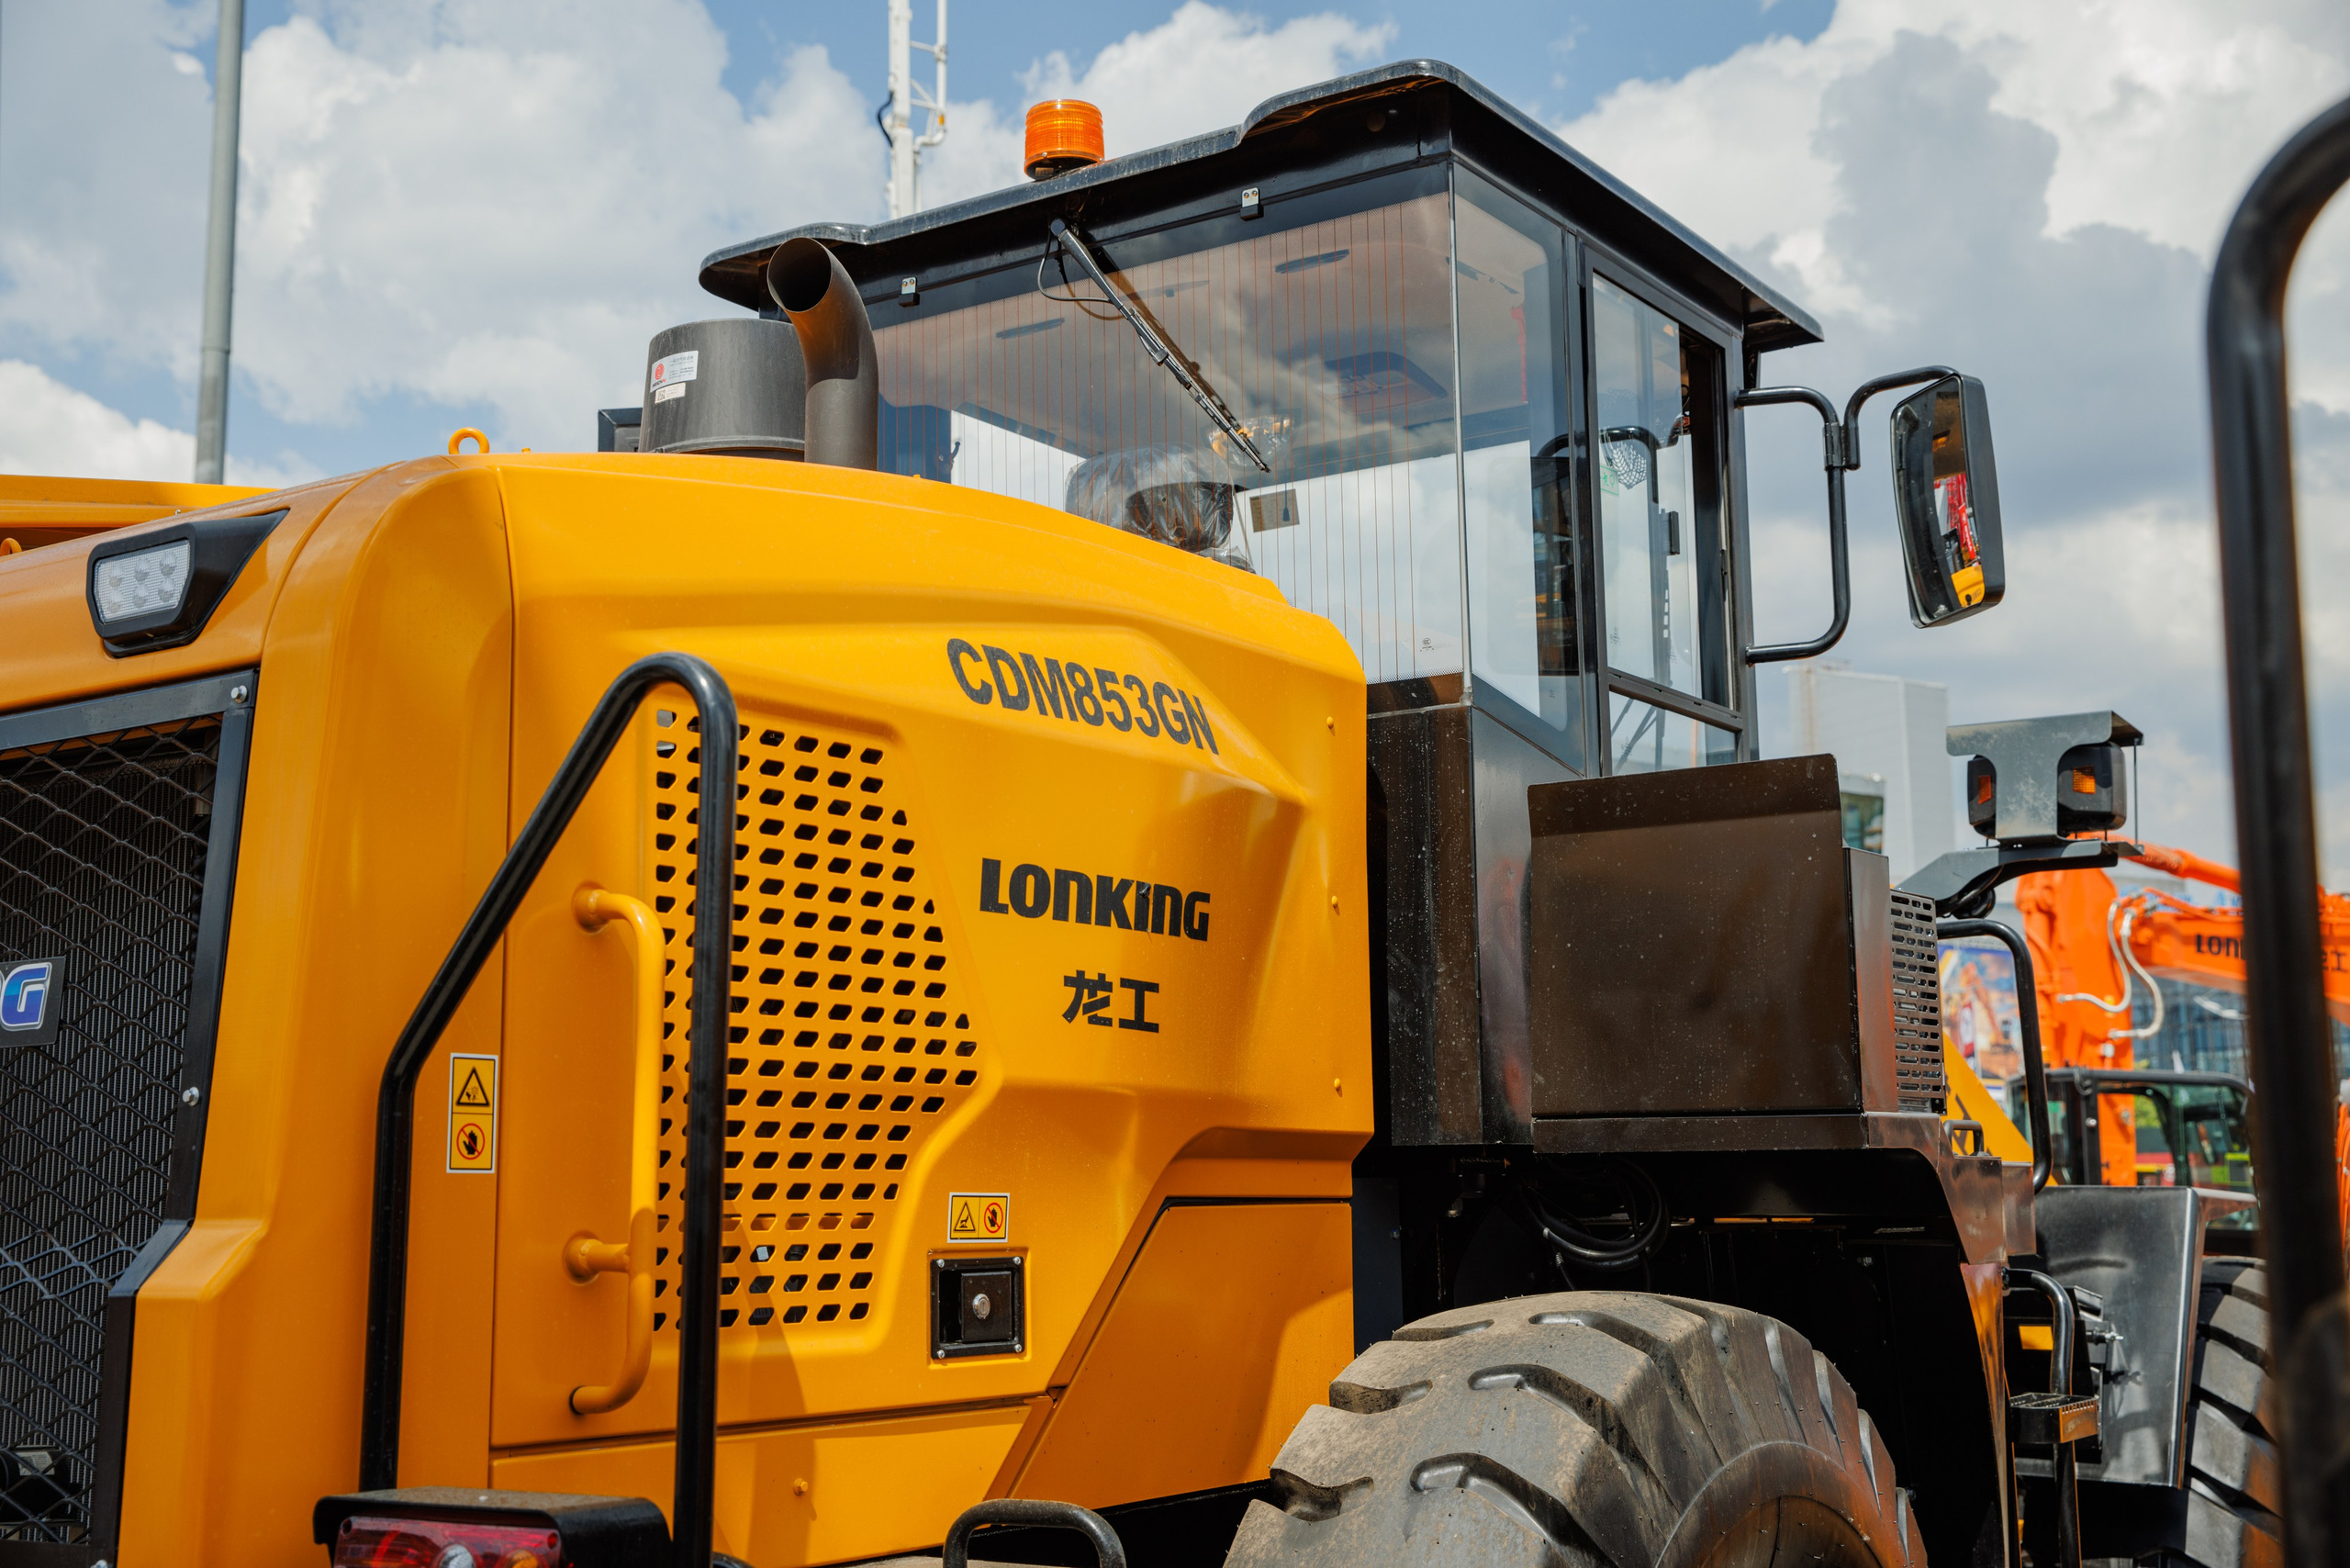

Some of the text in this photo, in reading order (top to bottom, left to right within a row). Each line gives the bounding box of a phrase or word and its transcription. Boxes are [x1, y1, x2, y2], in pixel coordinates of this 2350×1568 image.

[946, 638, 1219, 755] CDM853GN
[0, 961, 52, 1032] G
[1061, 969, 1159, 1034] 龙工
